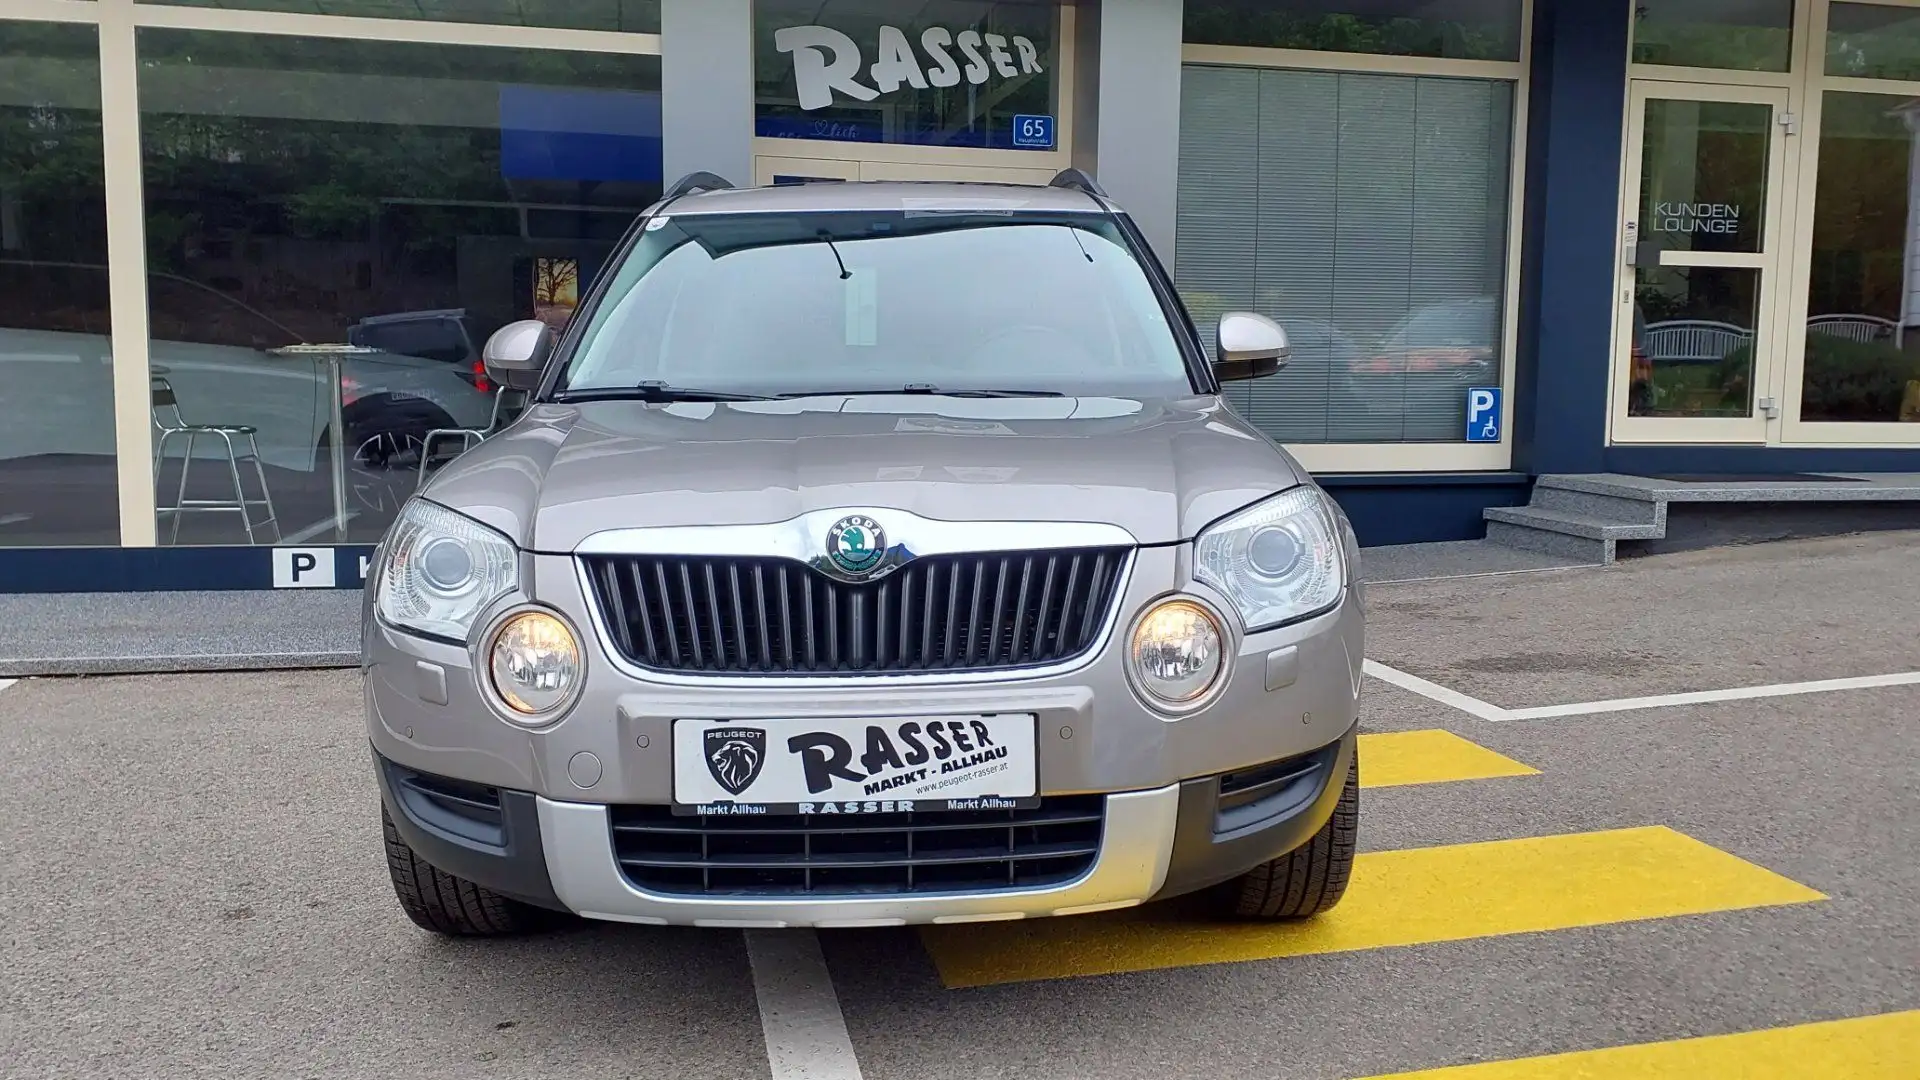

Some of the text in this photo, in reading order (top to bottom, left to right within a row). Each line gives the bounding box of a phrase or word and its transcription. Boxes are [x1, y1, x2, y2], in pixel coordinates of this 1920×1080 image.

[774, 25, 1043, 110] RASSER
[1023, 119, 1044, 137] 65
[1654, 202, 1739, 218] KUNDEN
[1653, 218, 1738, 233] LOUNGE
[1470, 391, 1494, 422] P
[291, 553, 316, 582] P
[707, 731, 762, 739] PEUGEOT
[787, 720, 994, 794] RASSER
[864, 768, 928, 796] MARKT
[941, 746, 1008, 774] ALLHAU
[915, 762, 1009, 795] www.peugeot-rasser.at
[697, 804, 766, 815] Markt Allhau
[798, 801, 915, 814] RASSER
[948, 799, 1016, 809] Markt Allhau
